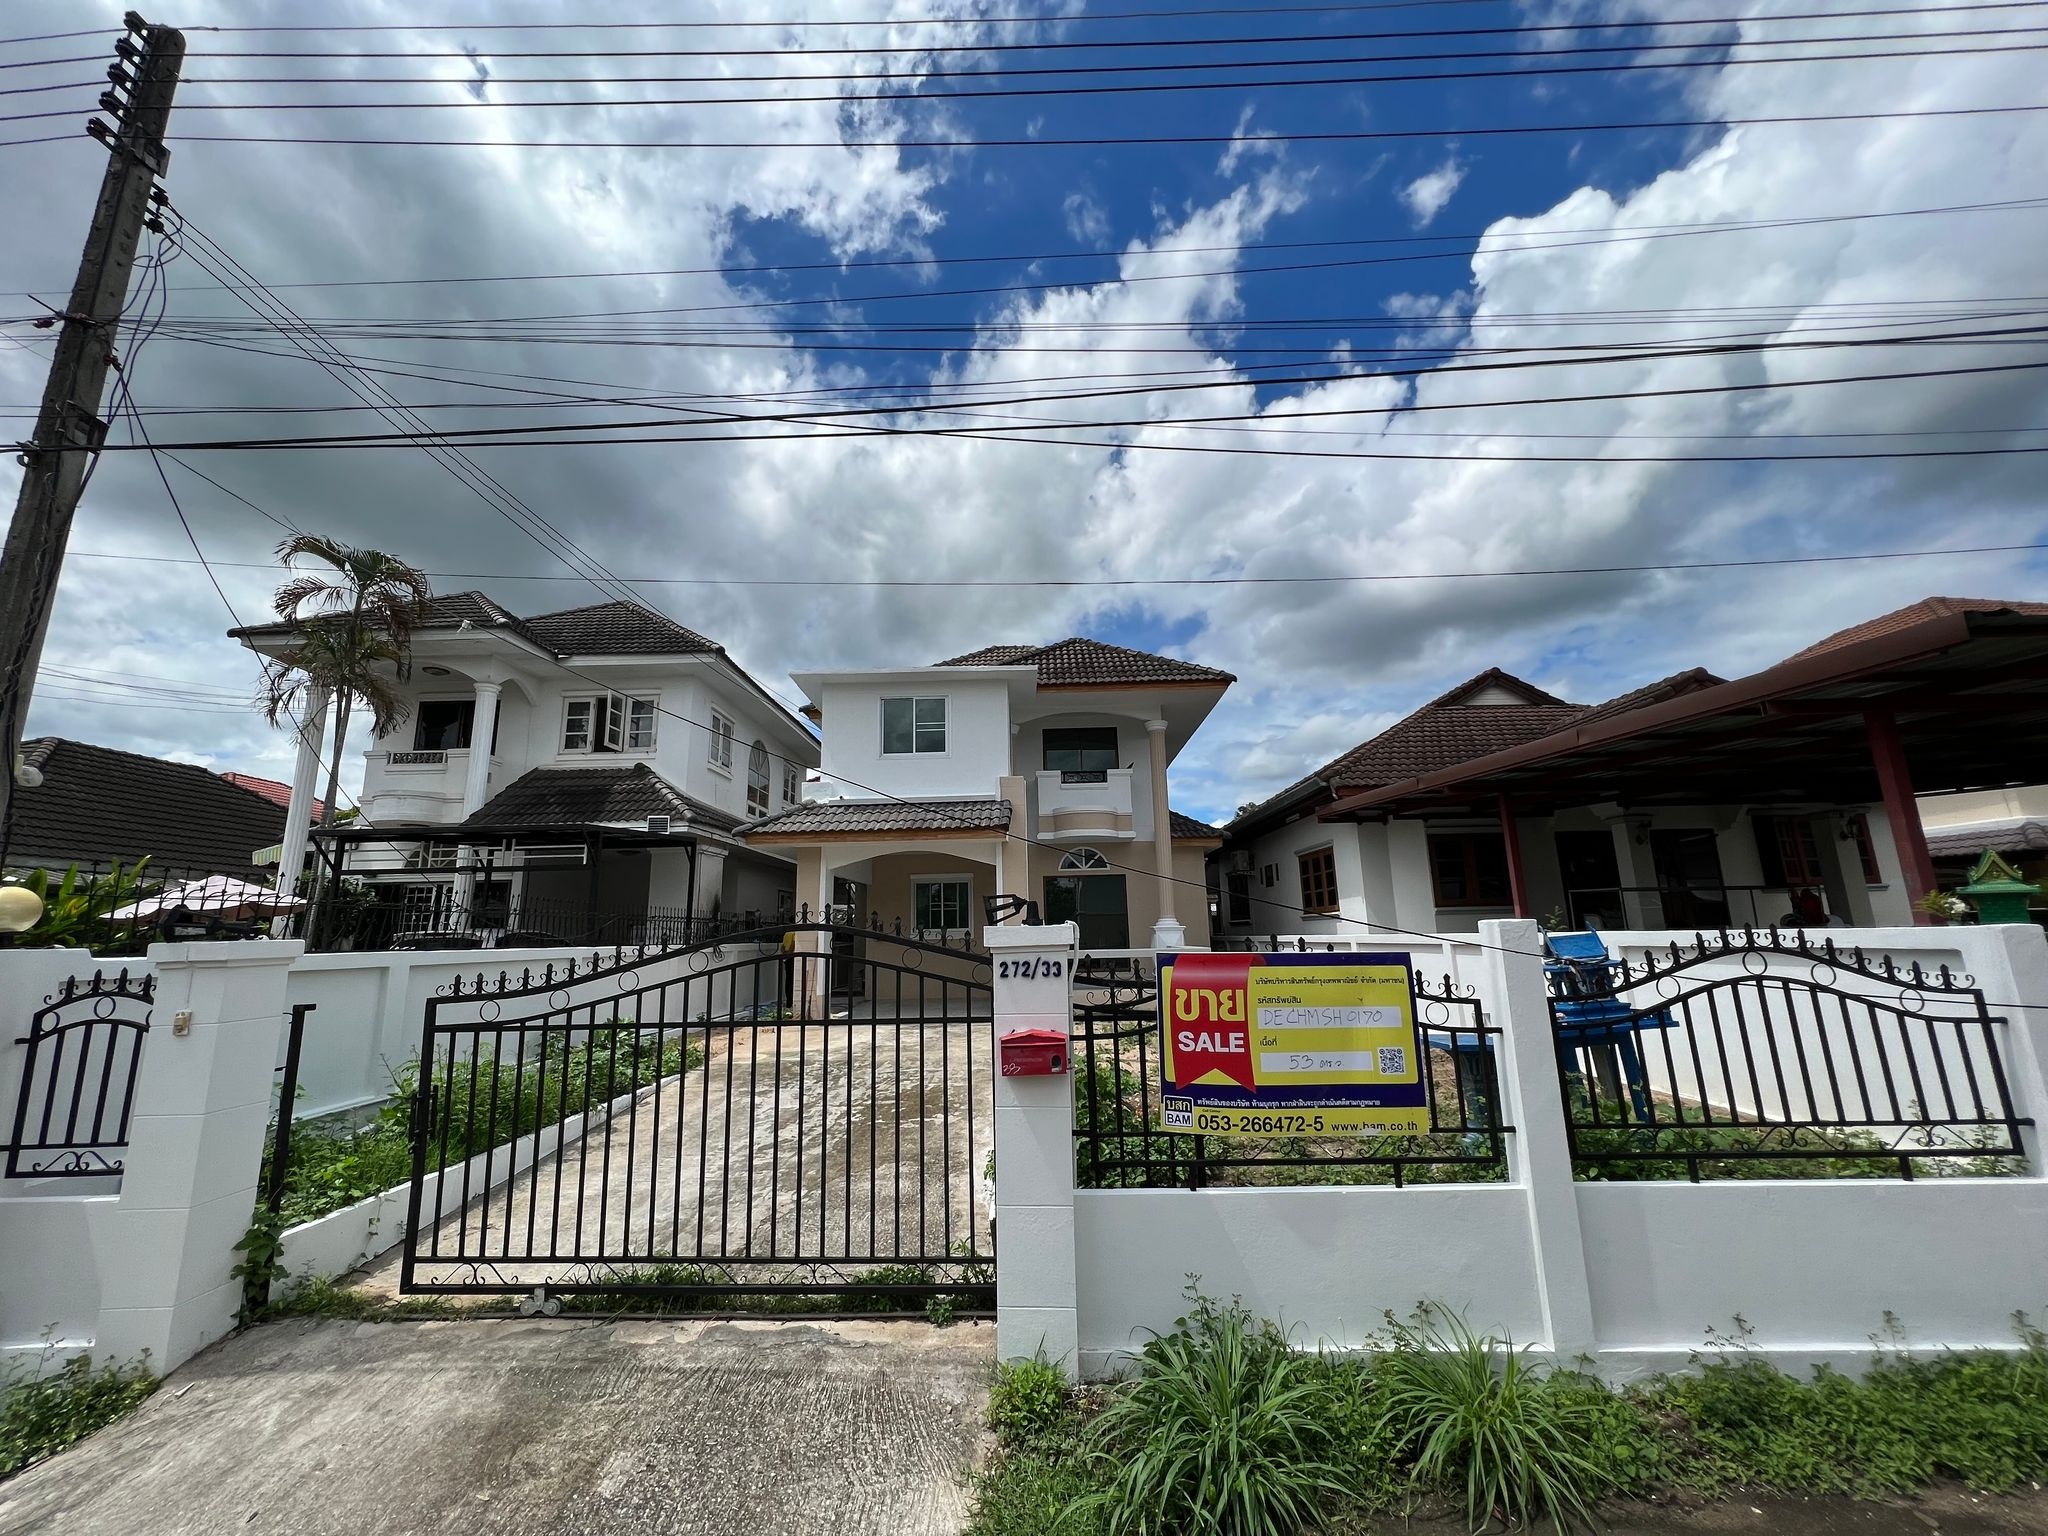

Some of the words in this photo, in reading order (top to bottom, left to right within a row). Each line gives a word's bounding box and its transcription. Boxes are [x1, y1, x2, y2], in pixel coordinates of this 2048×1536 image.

[1000, 957, 1062, 979] 272/33
[1175, 988, 1246, 1022] ขาย
[1178, 1031, 1245, 1053] SALE
[1259, 1036, 1278, 1047] เนื้อที่
[1289, 1055, 1314, 1070] 53
[1166, 1099, 1191, 1112] บสก
[1167, 1113, 1191, 1125] BAM
[1197, 1114, 1324, 1133] 053-266472-5
[1331, 1121, 1418, 1131] www.bam.co.th
